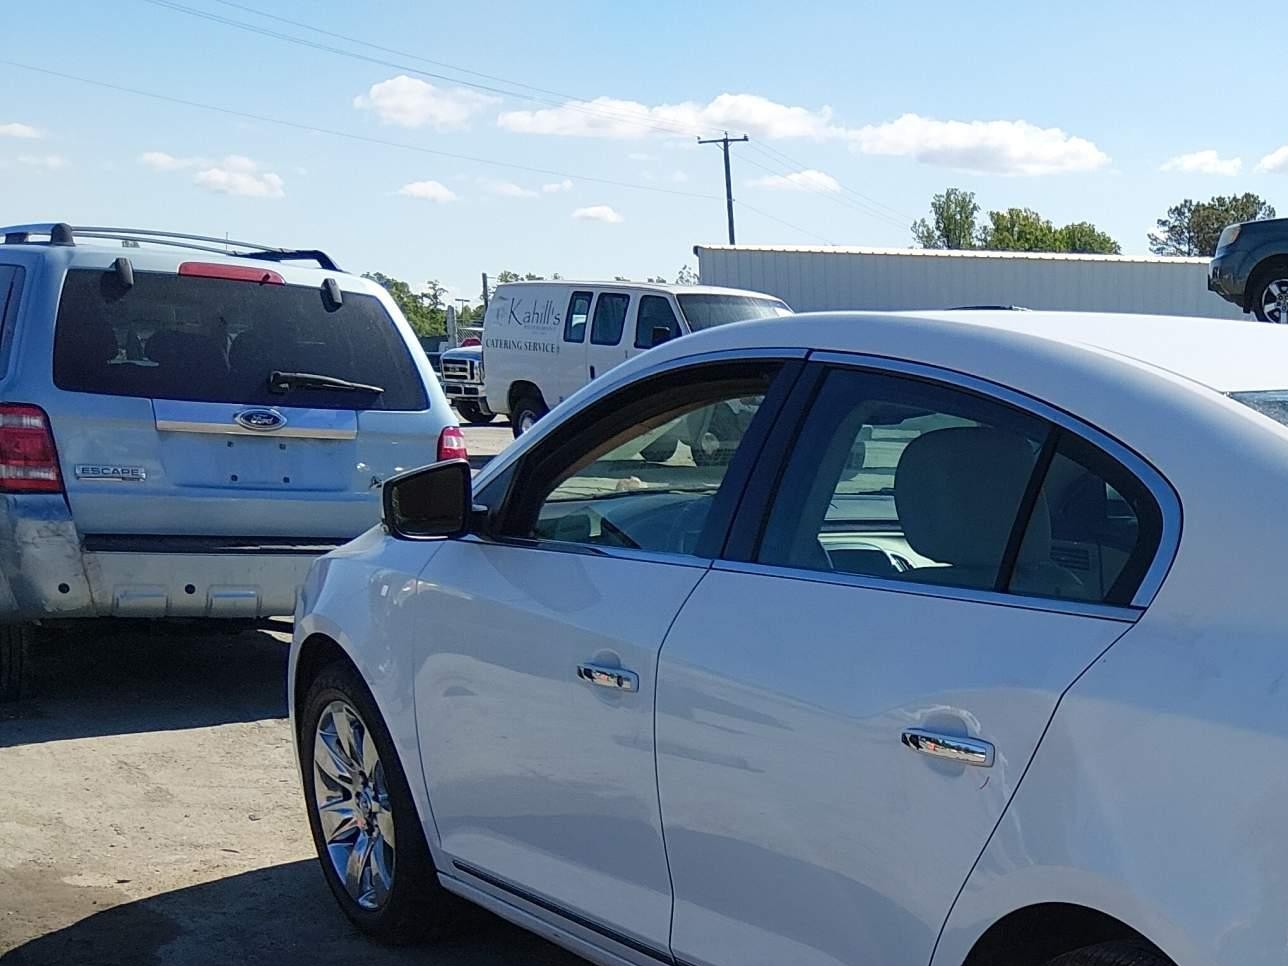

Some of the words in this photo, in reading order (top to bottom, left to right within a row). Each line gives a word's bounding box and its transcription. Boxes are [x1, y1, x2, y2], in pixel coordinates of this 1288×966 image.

[508, 297, 561, 326] Kahill's
[485, 338, 522, 350] CATERING
[250, 414, 274, 425] Ford
[81, 466, 140, 476] ESCAPE
